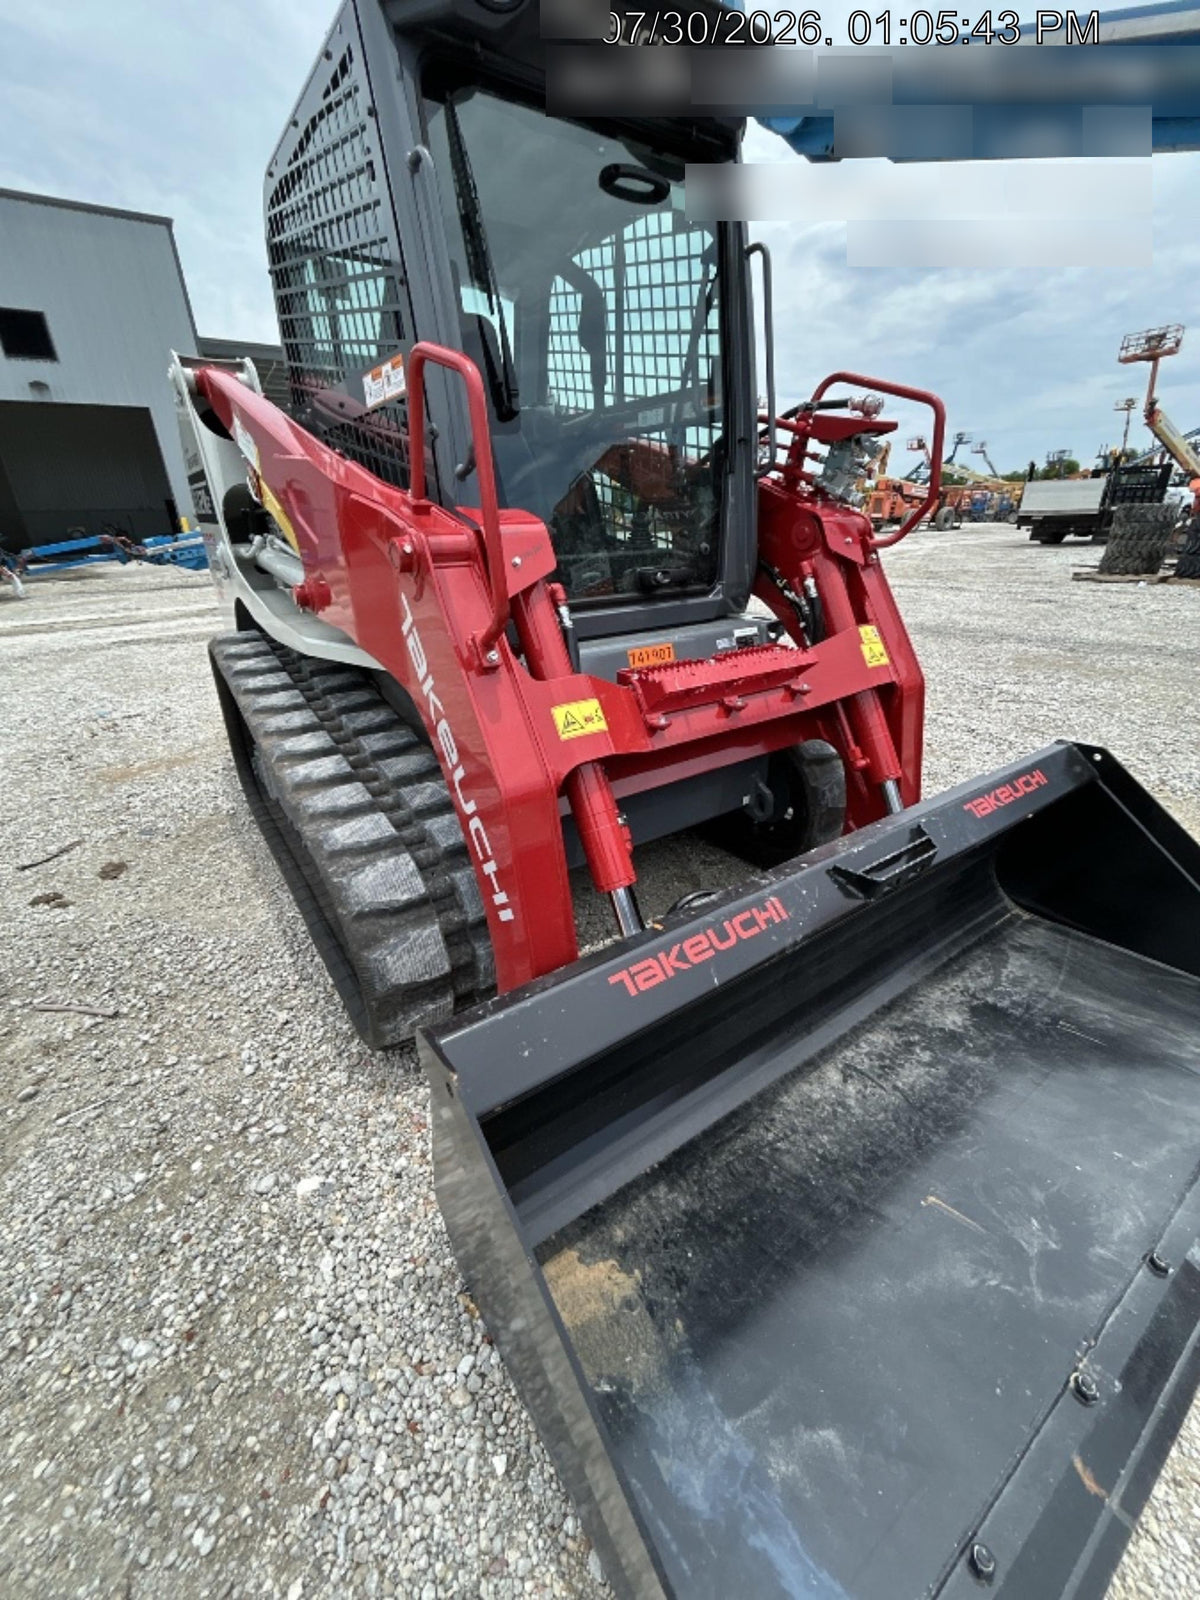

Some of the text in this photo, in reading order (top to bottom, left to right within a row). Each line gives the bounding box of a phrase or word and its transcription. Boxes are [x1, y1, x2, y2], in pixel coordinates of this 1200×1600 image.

[401, 592, 514, 922] TAKEUCHI
[963, 769, 1048, 818] TAKEUCHI
[607, 896, 790, 997] TAKEUCHI
